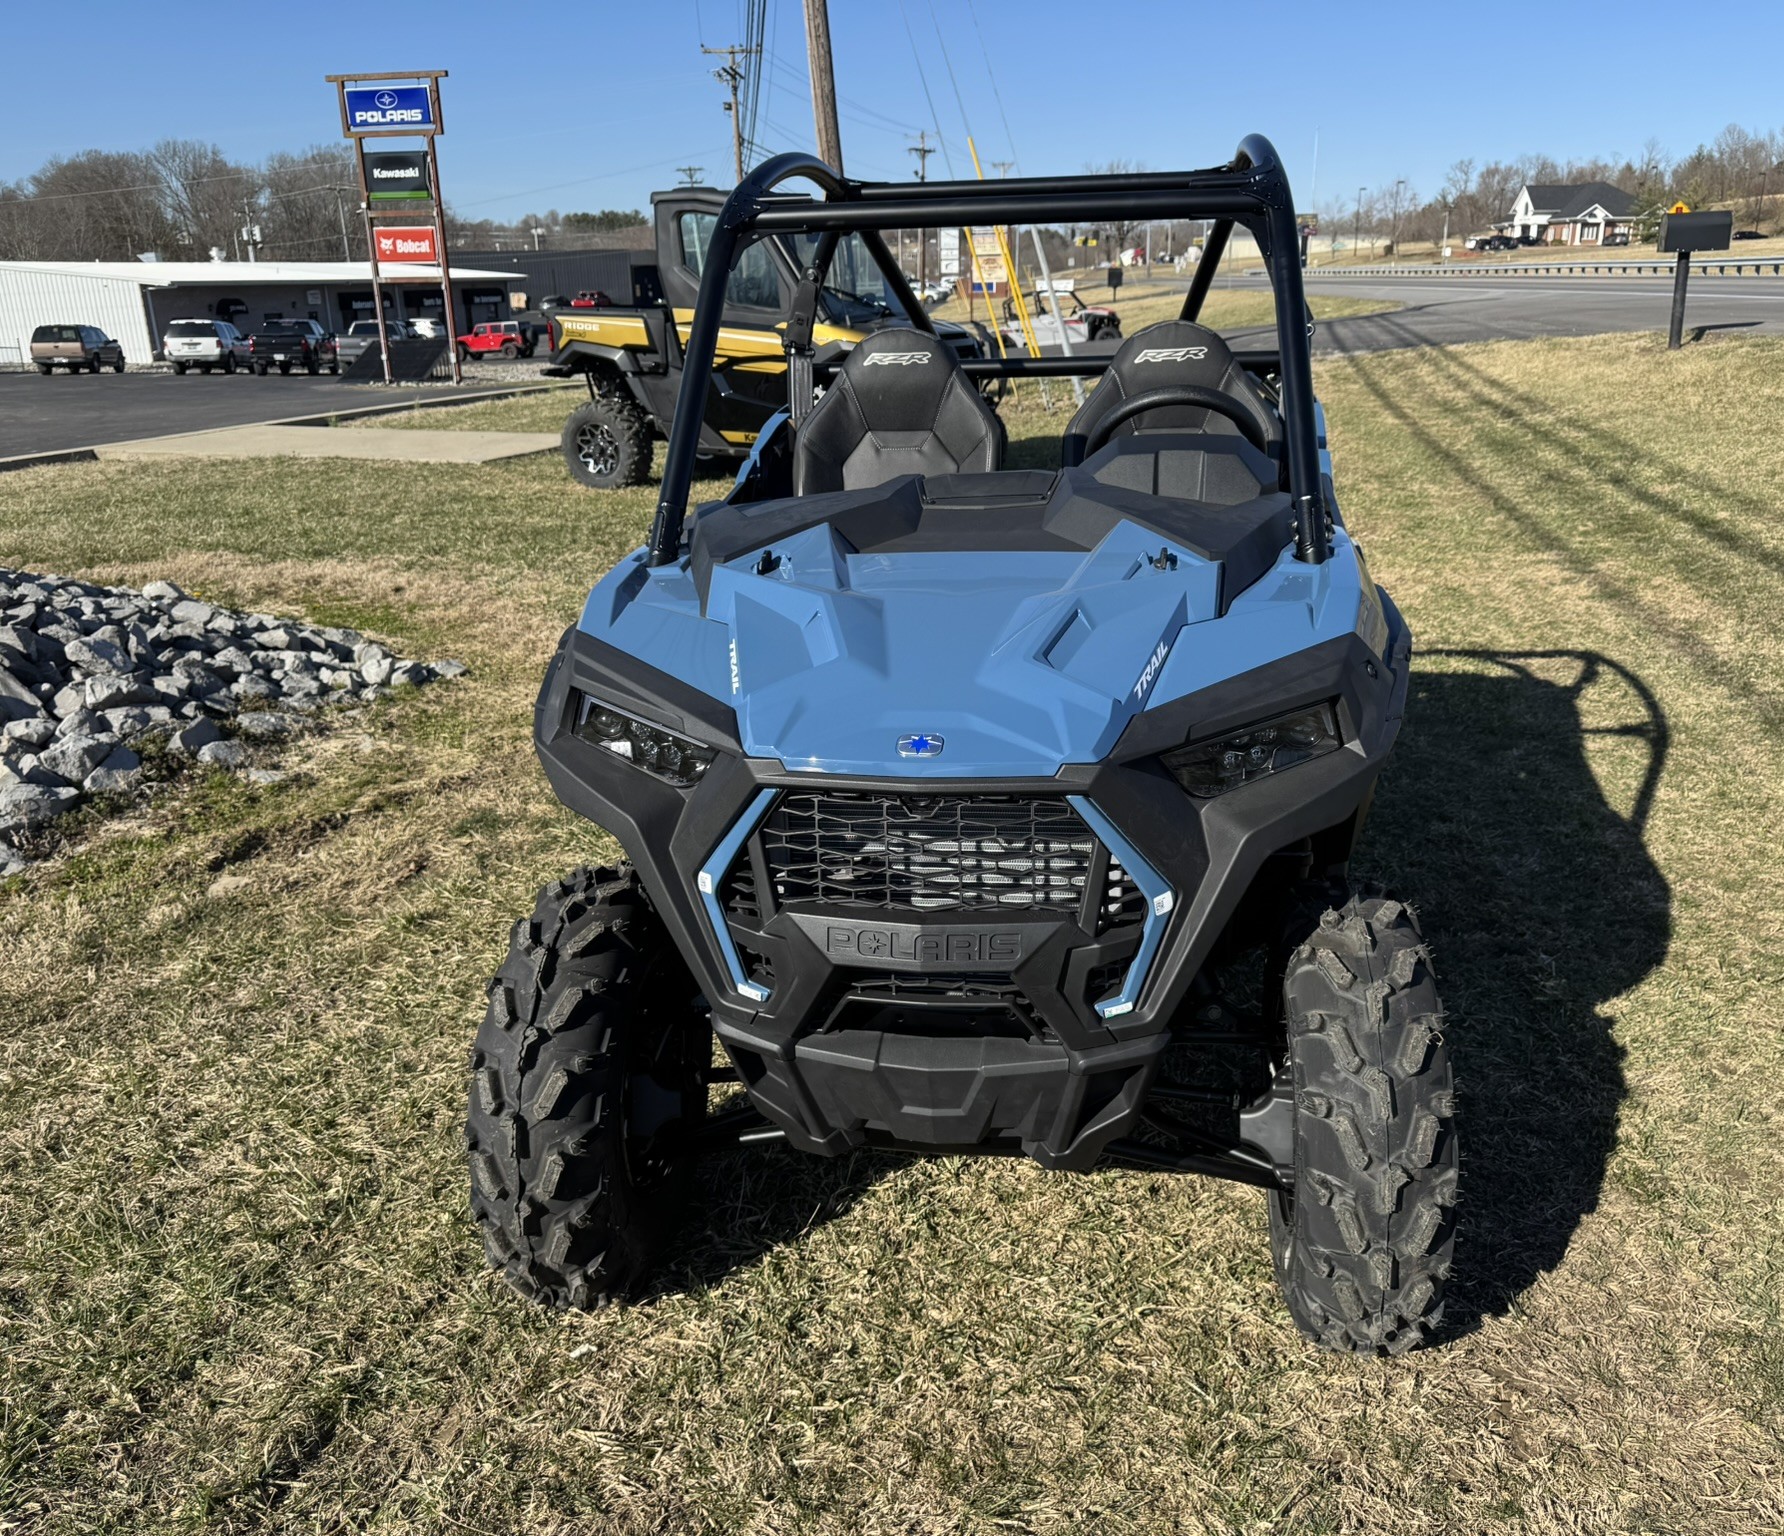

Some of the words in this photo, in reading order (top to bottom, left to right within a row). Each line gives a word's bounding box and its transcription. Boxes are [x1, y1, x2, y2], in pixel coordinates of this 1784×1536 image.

[355, 109, 423, 123] POLARIS
[373, 167, 419, 178] Kawasaki
[396, 239, 430, 253] Bobcat
[564, 321, 600, 331] RIDGE
[863, 352, 932, 366] RZR
[1133, 346, 1208, 364] RZR
[729, 638, 740, 695] TRAIL
[1133, 641, 1168, 700] TRAIL
[827, 926, 1022, 962] POLARIS
